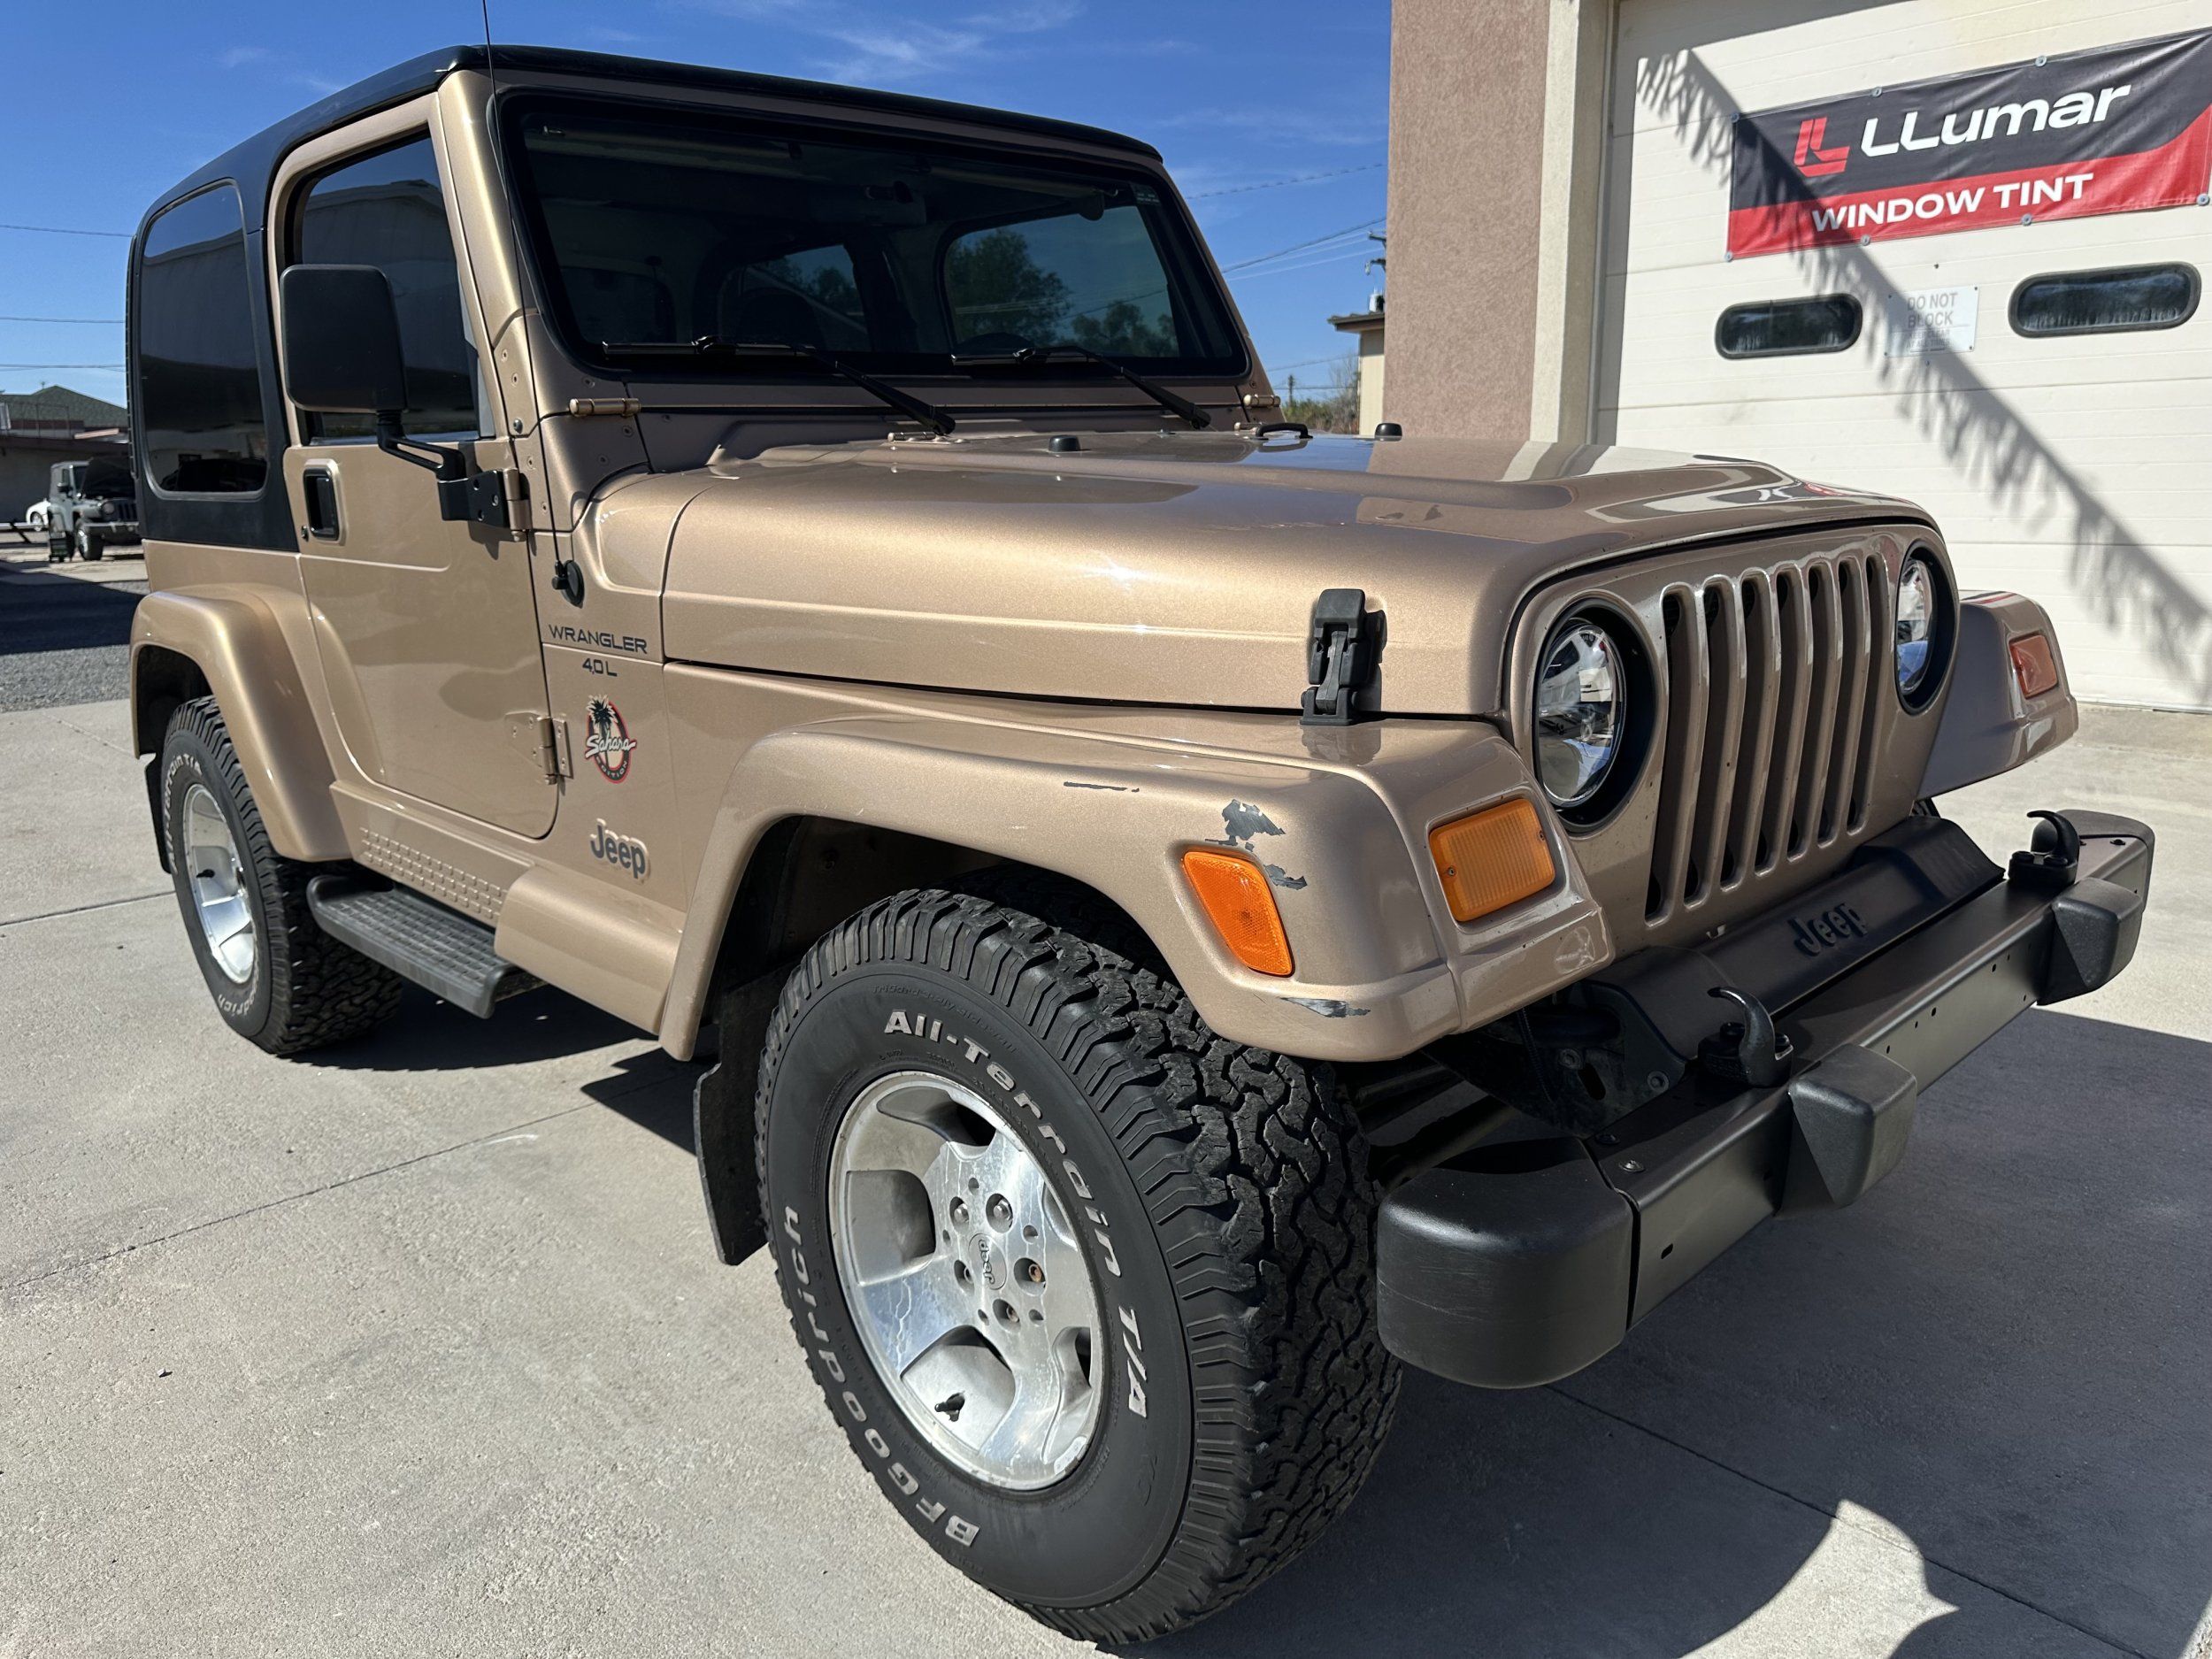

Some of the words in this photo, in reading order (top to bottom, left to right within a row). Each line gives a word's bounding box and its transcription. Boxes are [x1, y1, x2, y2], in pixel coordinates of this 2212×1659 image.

[1860, 84, 2131, 157] LLumar
[1812, 187, 1985, 232] WINDOW
[1993, 173, 2093, 209] TINT
[1908, 297, 1925, 311] DO
[1930, 293, 1958, 309] NOT
[1908, 311, 1954, 328] BLOCK
[548, 624, 648, 654] WRANGLER
[585, 731, 637, 758] Sahara
[589, 818, 649, 881] Jeep
[1787, 902, 1868, 956] Jeep
[885, 1009, 1122, 1277] All-Terrain
[1118, 1304, 1148, 1418] T/A
[979, 1239, 995, 1285] Jeep
[784, 1205, 980, 1548] BFGoodrich
